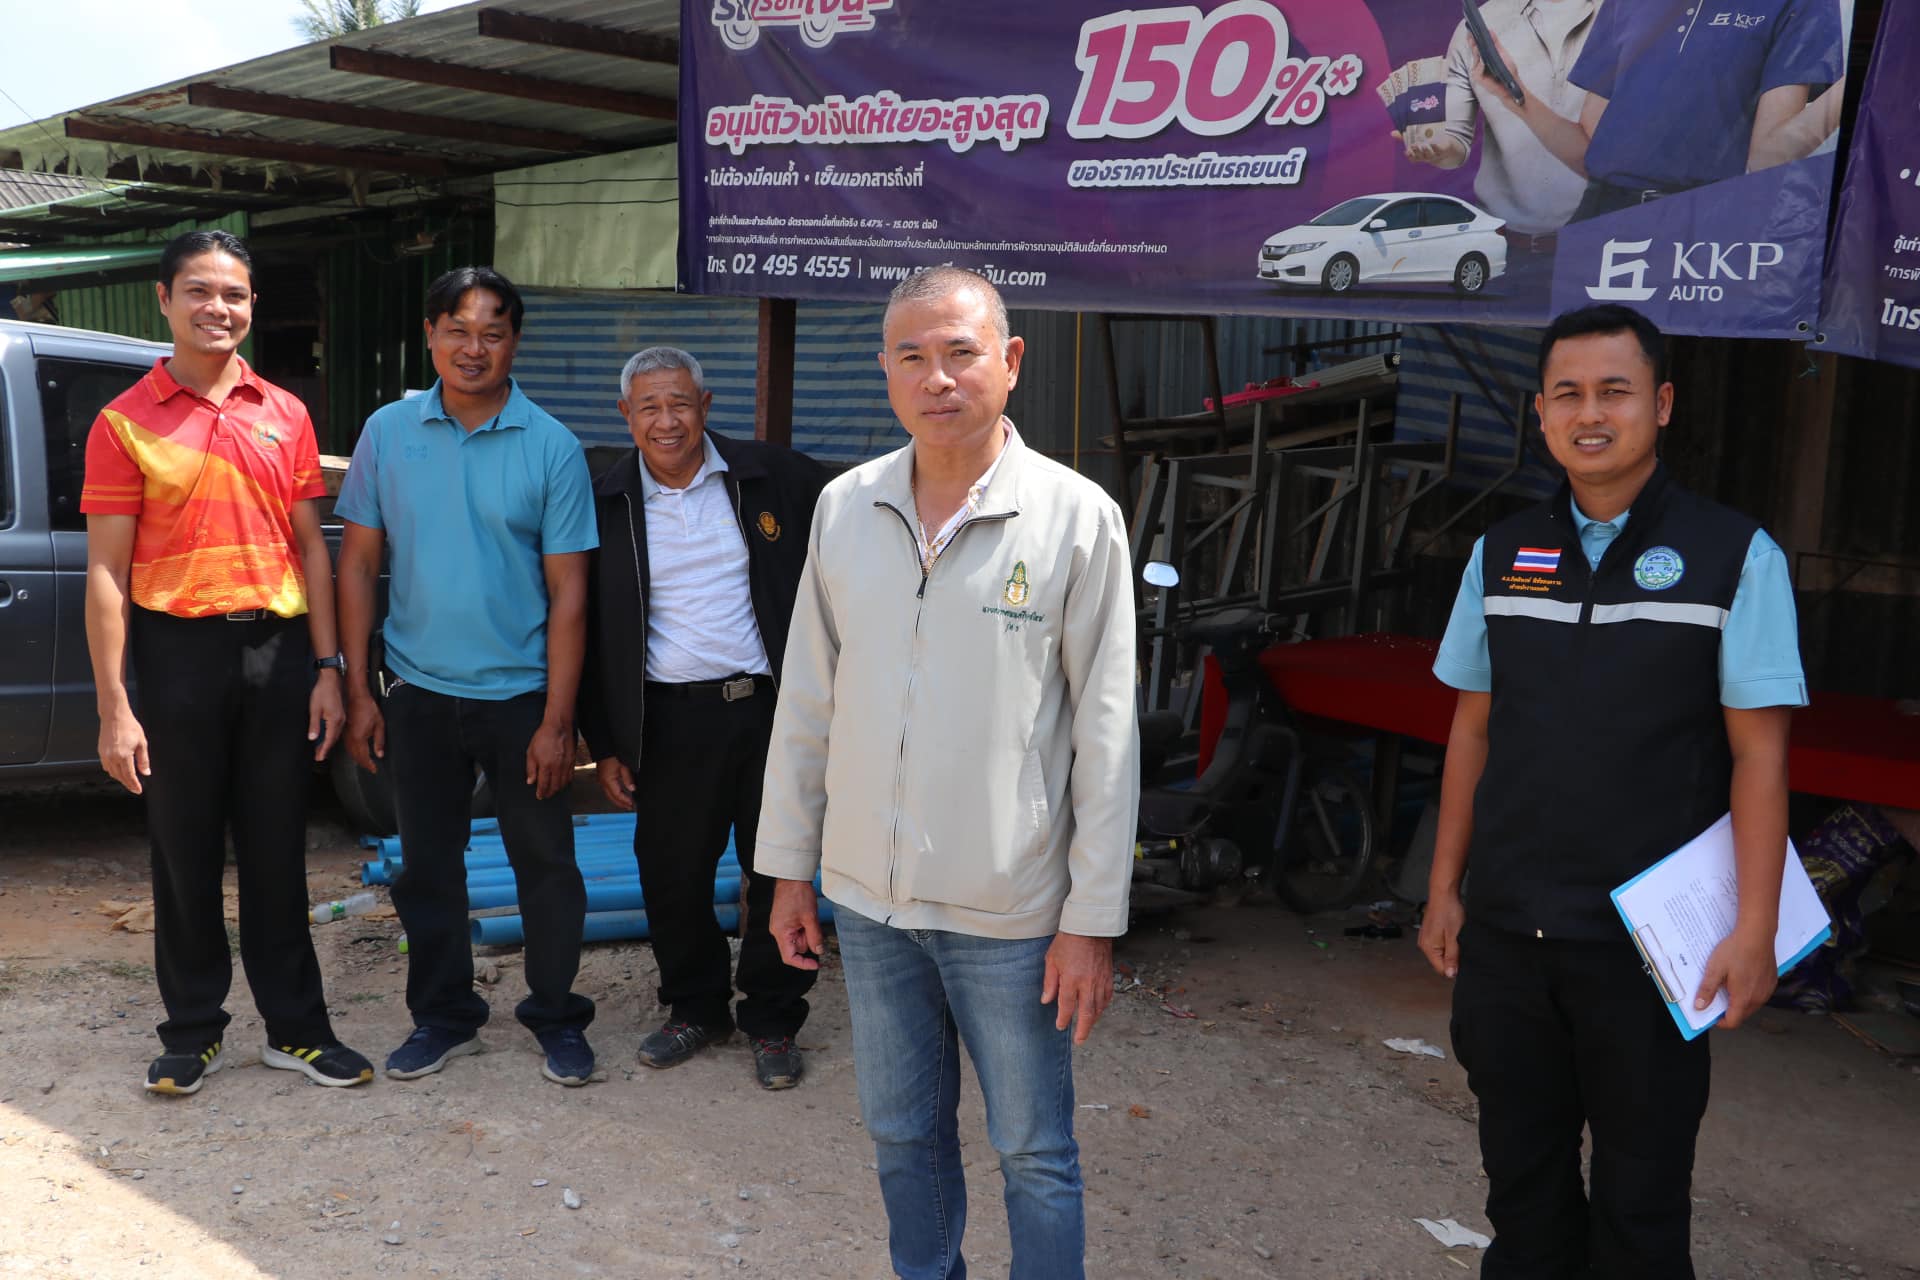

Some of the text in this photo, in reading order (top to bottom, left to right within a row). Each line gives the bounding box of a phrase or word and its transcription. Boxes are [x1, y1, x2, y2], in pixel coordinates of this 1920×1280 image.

[708, 96, 1043, 147] อนุมัติวงเงินให้เยอะสูงสุด
[1071, 153, 1300, 181] ของราคาประเมินรถยนต์
[732, 253, 755, 274] 02
[762, 254, 798, 275] 495
[803, 255, 851, 278] 4555
[1672, 241, 1784, 280] KKP
[1668, 285, 1724, 302] AUTO
